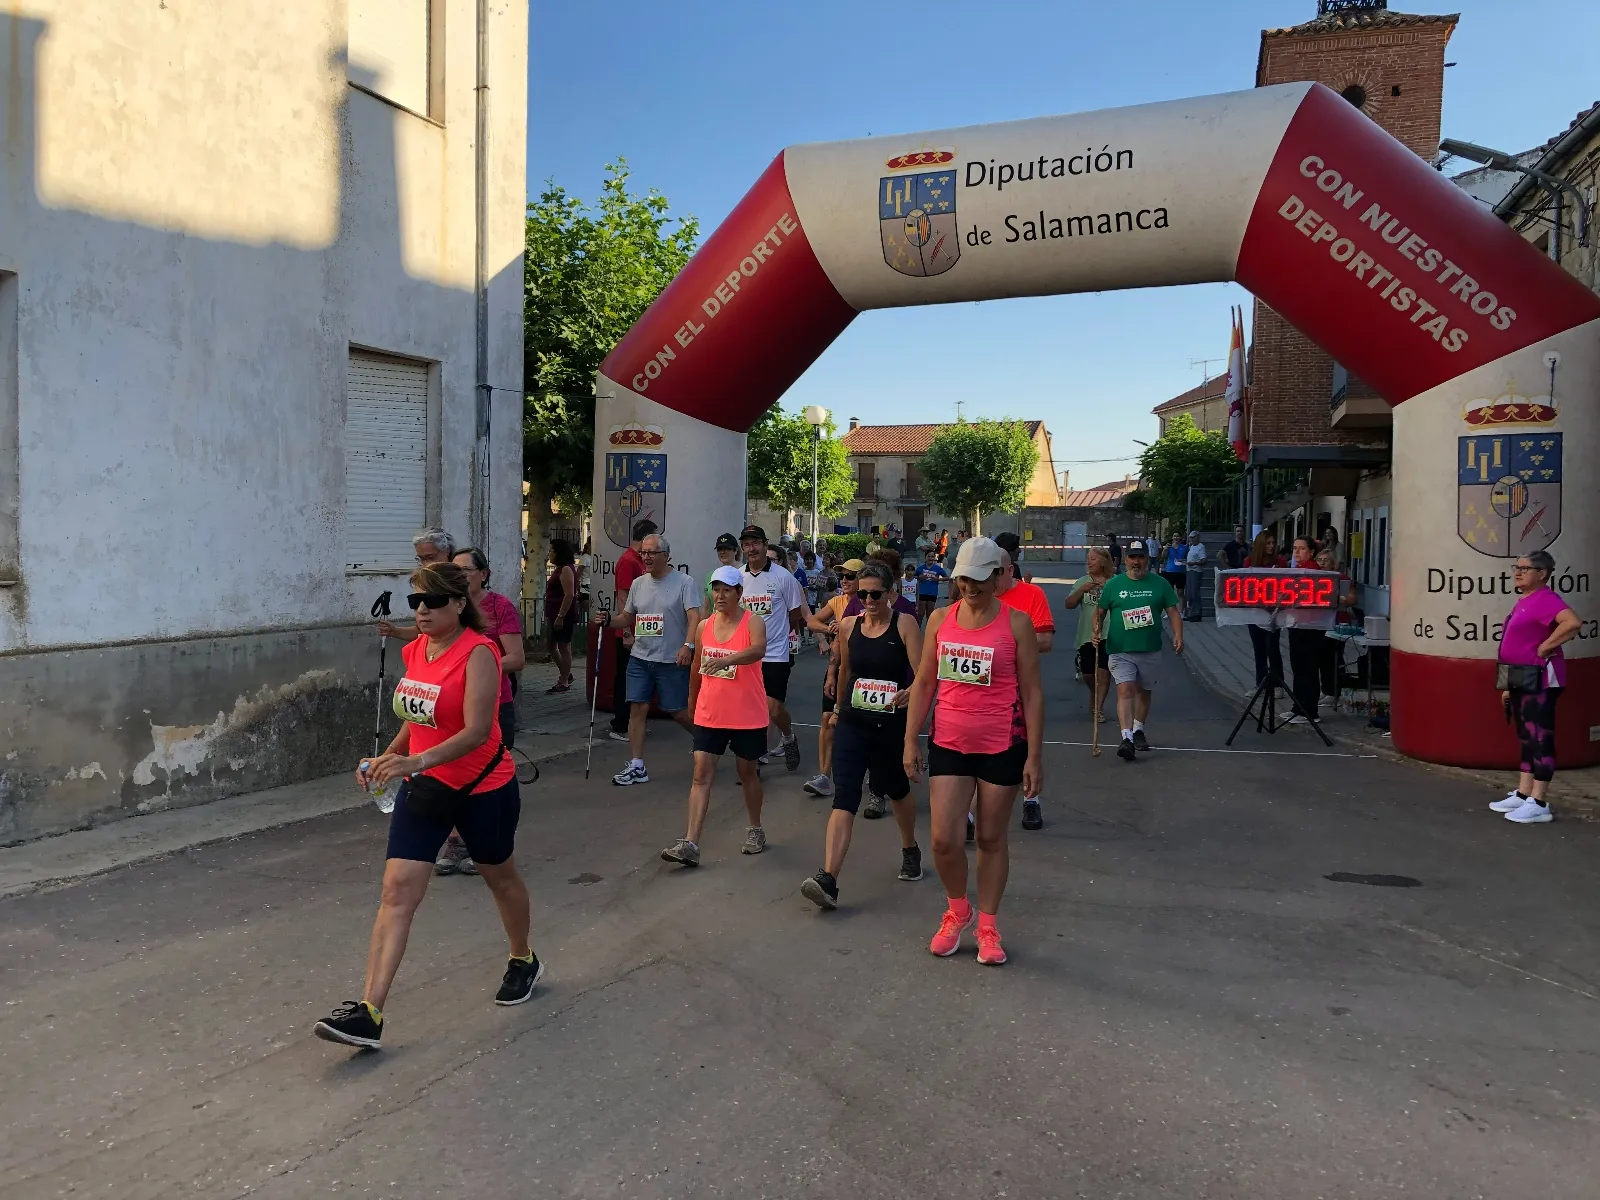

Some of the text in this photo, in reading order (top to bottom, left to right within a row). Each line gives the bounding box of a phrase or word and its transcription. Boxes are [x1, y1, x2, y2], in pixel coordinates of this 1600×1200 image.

[965, 145, 1134, 190] Diputación
[966, 207, 1170, 248] de Salamanca
[1299, 155, 1517, 331] CON NUESTROS
[1278, 194, 1469, 352] DEPORTISTAS
[632, 212, 798, 392] CON EL DEPORTE
[1225, 576, 1333, 606] 00:05:32
[749, 602, 767, 612] 172
[641, 621, 658, 631] 180
[1130, 614, 1147, 624] 175
[1413, 618, 1435, 639] de
[941, 644, 992, 661] bedunia
[951, 657, 981, 675] 165
[861, 690, 887, 704] 161
